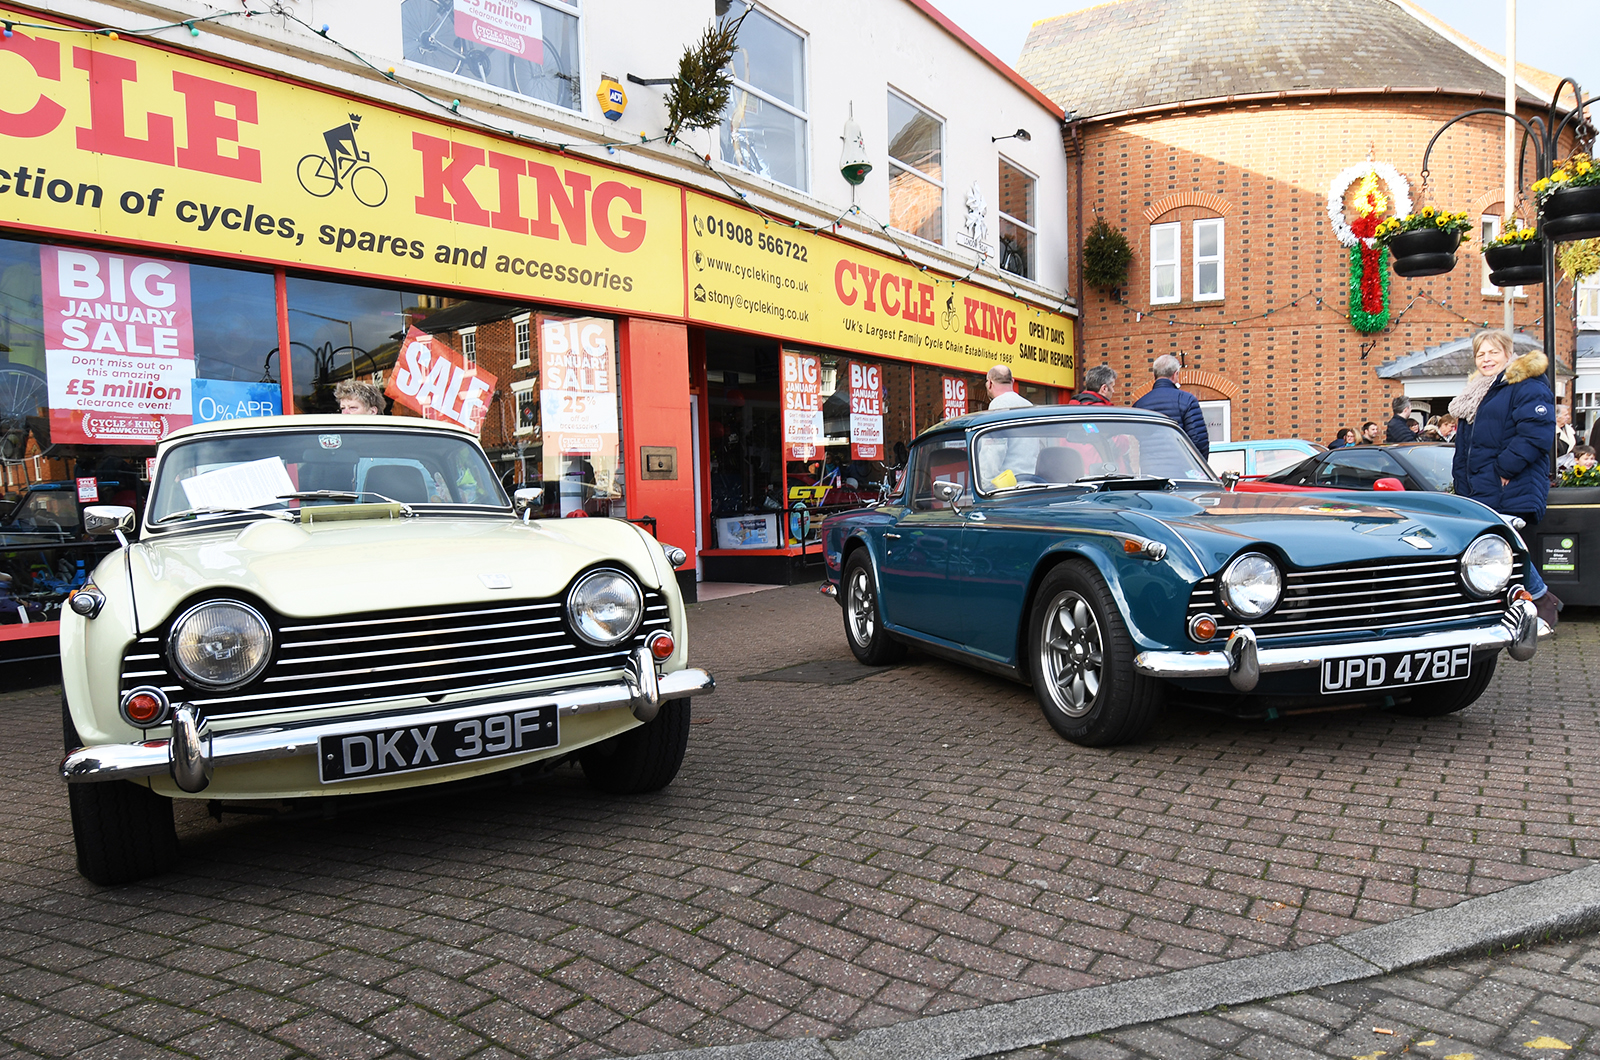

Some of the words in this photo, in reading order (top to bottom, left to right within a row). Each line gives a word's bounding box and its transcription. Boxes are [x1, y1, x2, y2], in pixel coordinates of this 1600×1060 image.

[469, 6, 503, 25] clearance
[505, 20, 526, 32] event!
[484, 0, 532, 25] million
[610, 92, 622, 103] ADT
[412, 130, 647, 254] KING
[120, 188, 165, 217] of
[176, 200, 304, 246] cycles,
[318, 223, 424, 261] spares
[434, 243, 487, 270] and
[495, 254, 634, 293] accessories
[707, 215, 753, 247] 01908
[758, 232, 808, 263] 566722
[57, 250, 177, 308] BIG
[707, 257, 809, 292] www.cycleking.co.uk
[60, 300, 177, 327] JANUARY
[708, 290, 809, 322] stony@cycleking.co.uk
[834, 258, 936, 327] CYCLE
[963, 296, 1017, 346] KING
[62, 318, 180, 357] SALE
[543, 319, 607, 357] BIG
[866, 322, 896, 341] Largest
[898, 326, 923, 347] Family
[924, 335, 944, 351] Cycle
[945, 340, 964, 354] Chain
[964, 344, 998, 361] Established
[1028, 320, 1045, 340] OPEN
[1045, 327, 1050, 340] 7
[1050, 327, 1065, 346] DAYS
[72, 355, 105, 367] Don't
[107, 358, 133, 368] miss
[137, 361, 155, 370] out
[159, 363, 173, 371] on
[546, 354, 606, 370] JANUARY
[784, 355, 817, 383] BIG
[1019, 343, 1038, 361] SAME
[1038, 348, 1049, 365] DAY
[1050, 350, 1074, 370] REPAIRS
[87, 367, 108, 377] this
[111, 370, 160, 382] amazing
[395, 341, 490, 430] SALE
[546, 366, 609, 392] SALE
[851, 364, 879, 390] BIG
[65, 378, 95, 396] £5
[102, 379, 182, 400] million
[785, 383, 817, 394] JANUARY
[786, 392, 818, 410] SALE
[852, 388, 878, 399] JANUARY
[944, 378, 965, 401] BIG
[76, 397, 134, 408] clearance
[137, 401, 172, 410] event!
[199, 397, 234, 421] 0%
[235, 400, 273, 417] APR
[563, 395, 596, 414] 25%
[852, 398, 879, 415] SALE
[90, 419, 126, 428] CYCLE
[134, 420, 161, 430] KING
[853, 428, 860, 436] £5
[860, 427, 880, 437] million
[788, 486, 833, 500] GT
[1324, 656, 1386, 690] UPD
[1393, 647, 1469, 683] 478F
[341, 725, 439, 774] DKX
[453, 709, 541, 758] 39F
